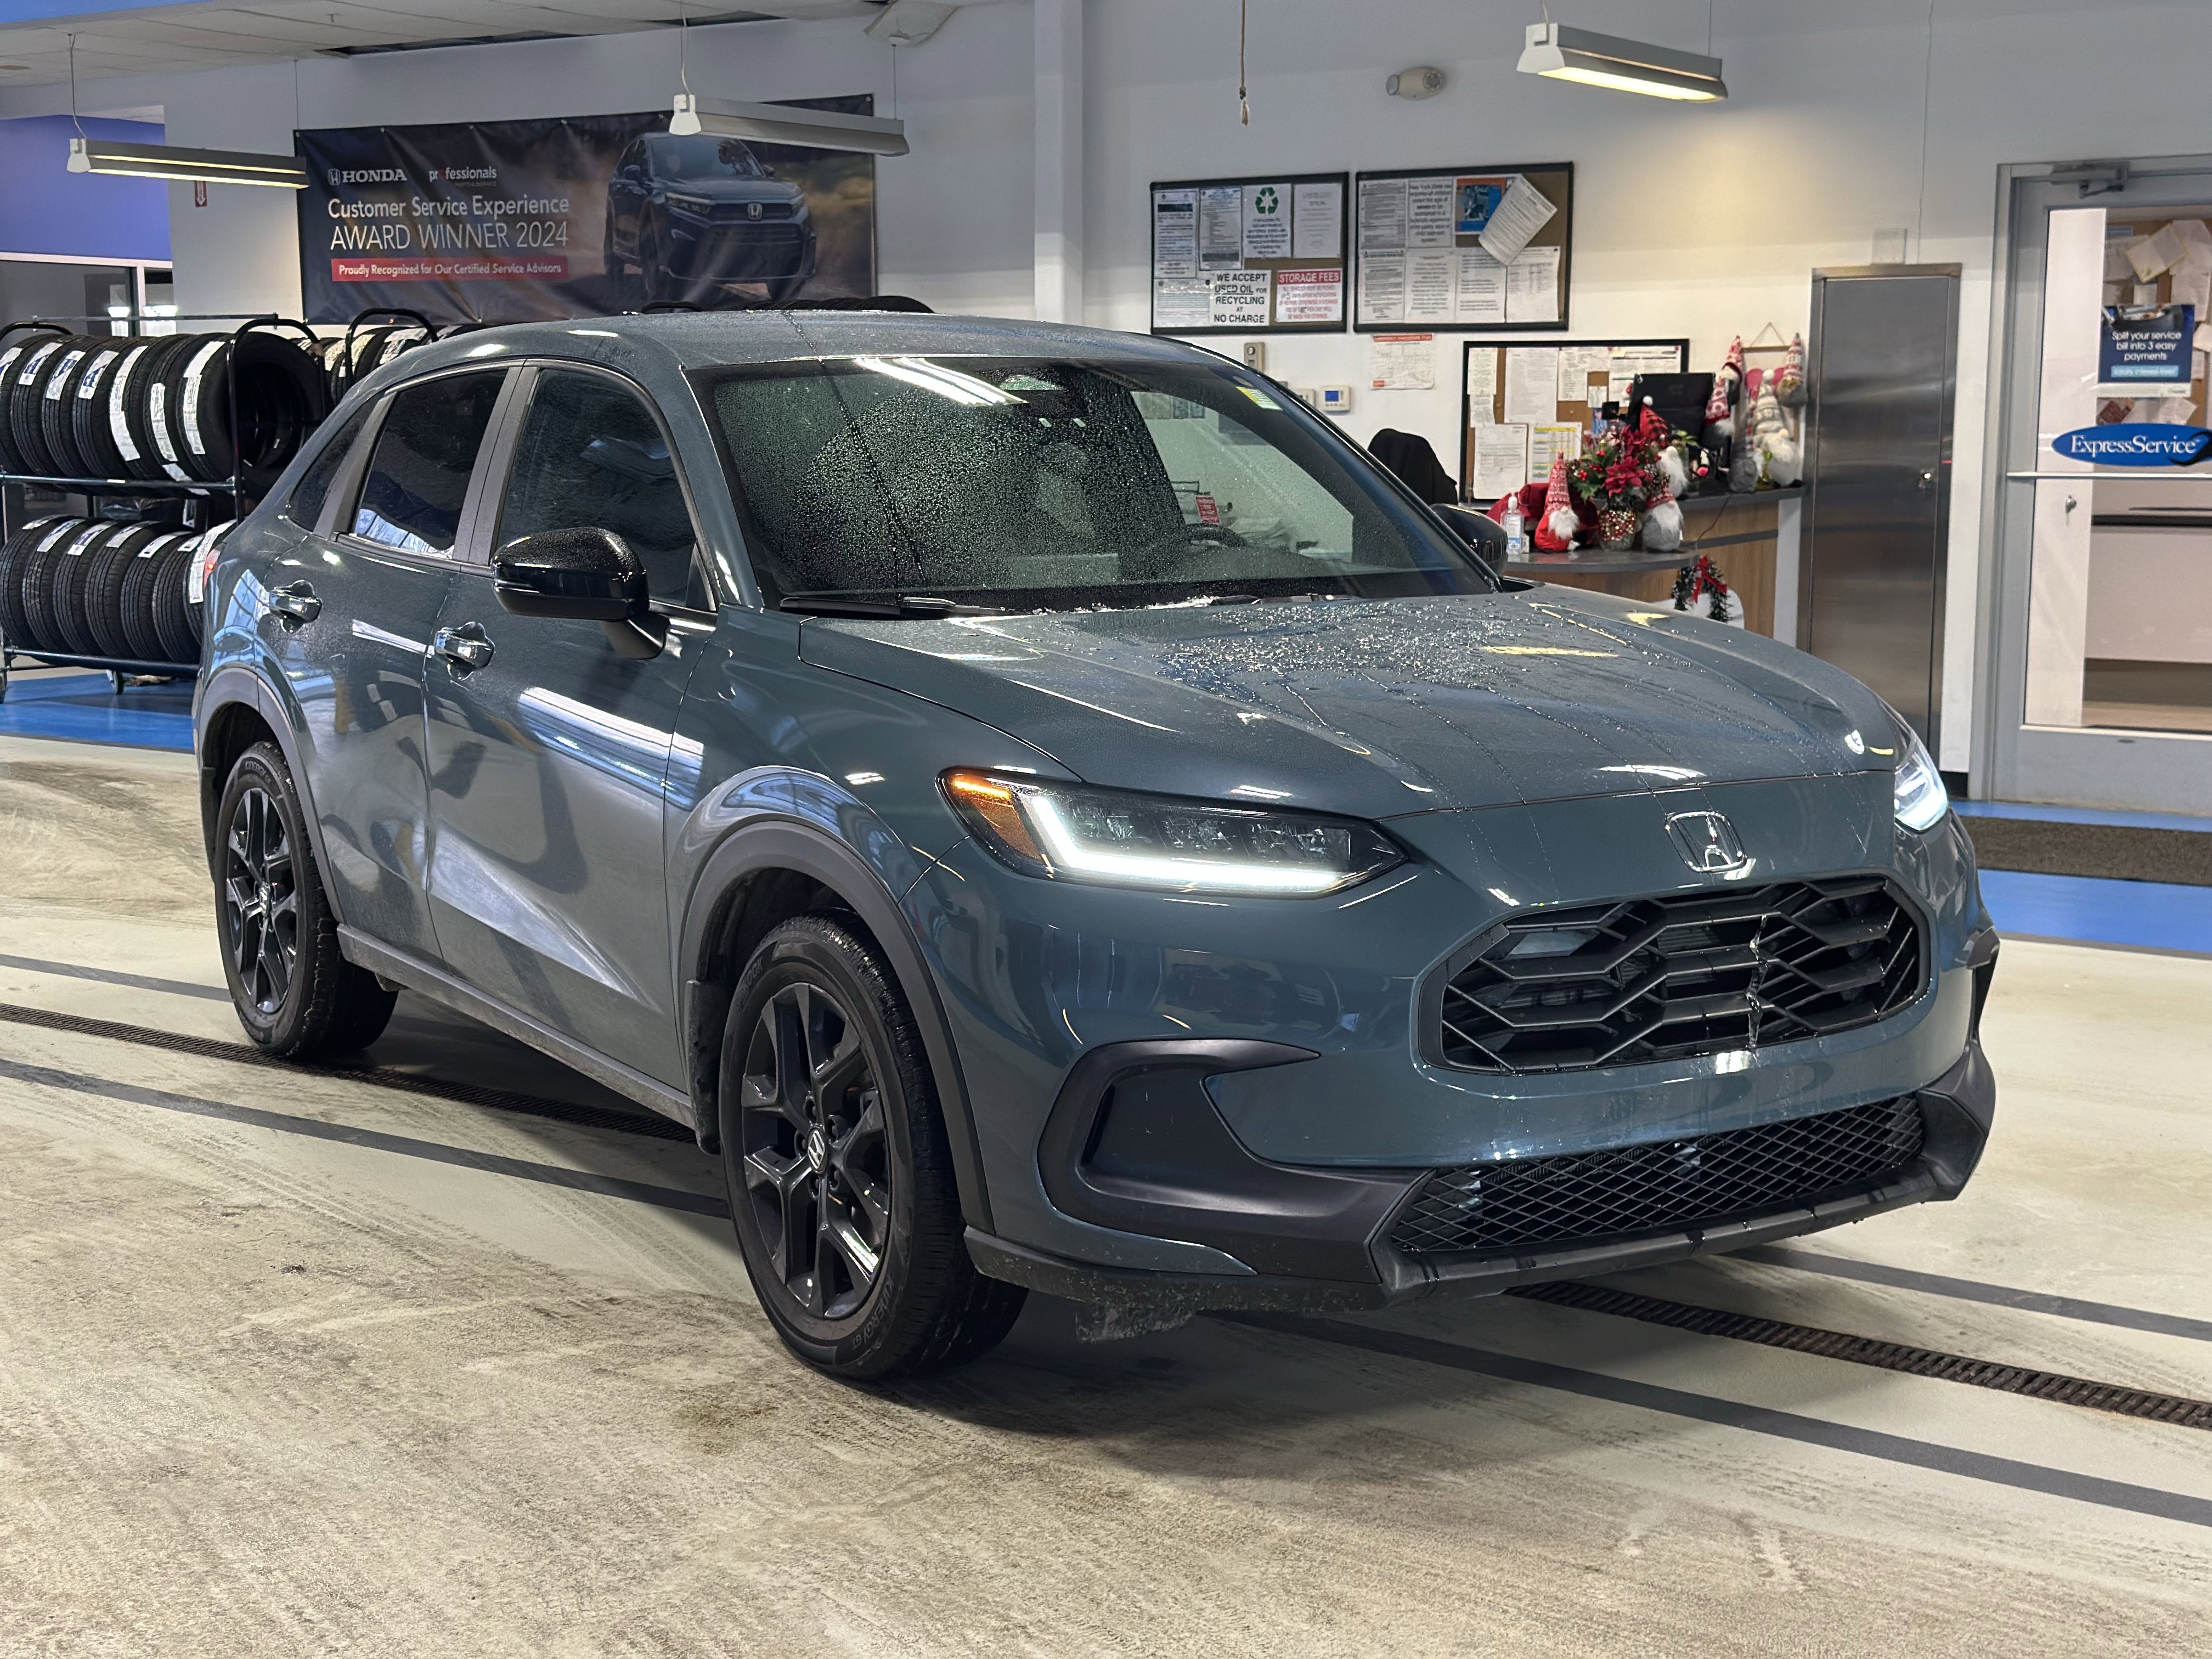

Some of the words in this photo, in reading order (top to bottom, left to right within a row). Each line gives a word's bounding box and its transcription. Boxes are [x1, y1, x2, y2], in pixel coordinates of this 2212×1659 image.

[341, 169, 407, 183] HONDA
[328, 198, 406, 218] Customer
[412, 196, 468, 217] Service
[473, 194, 569, 219] Experience
[330, 225, 410, 250] AWARD
[418, 223, 510, 249] WINNER
[516, 221, 568, 247] 2024
[339, 264, 369, 278] Proudly
[371, 263, 419, 277] Recognized
[421, 263, 432, 274] for
[435, 263, 452, 275] Our
[454, 262, 490, 274] Certified
[492, 262, 524, 274] Service
[527, 262, 562, 273] Advisors
[1216, 273, 1230, 281] WE
[1232, 273, 1267, 281] ACCEPT
[1279, 272, 1317, 283] STORAGE
[1318, 271, 1339, 282] FEES
[1215, 285, 1238, 293] USED
[1239, 285, 1254, 293] OIL
[1215, 296, 1265, 304] RECYCLING
[1214, 314, 1227, 323] NO
[1228, 314, 1265, 323] CHARGE
[2112, 331, 2129, 341] Split
[2131, 332, 2149, 341] your
[2151, 330, 2182, 340] service
[2116, 341, 2128, 350] bill
[2130, 341, 2146, 350] into
[2147, 341, 2154, 350] 3
[2155, 342, 2177, 352] easy
[2124, 352, 2167, 362] payments
[2070, 435, 2196, 458] ExpressService
